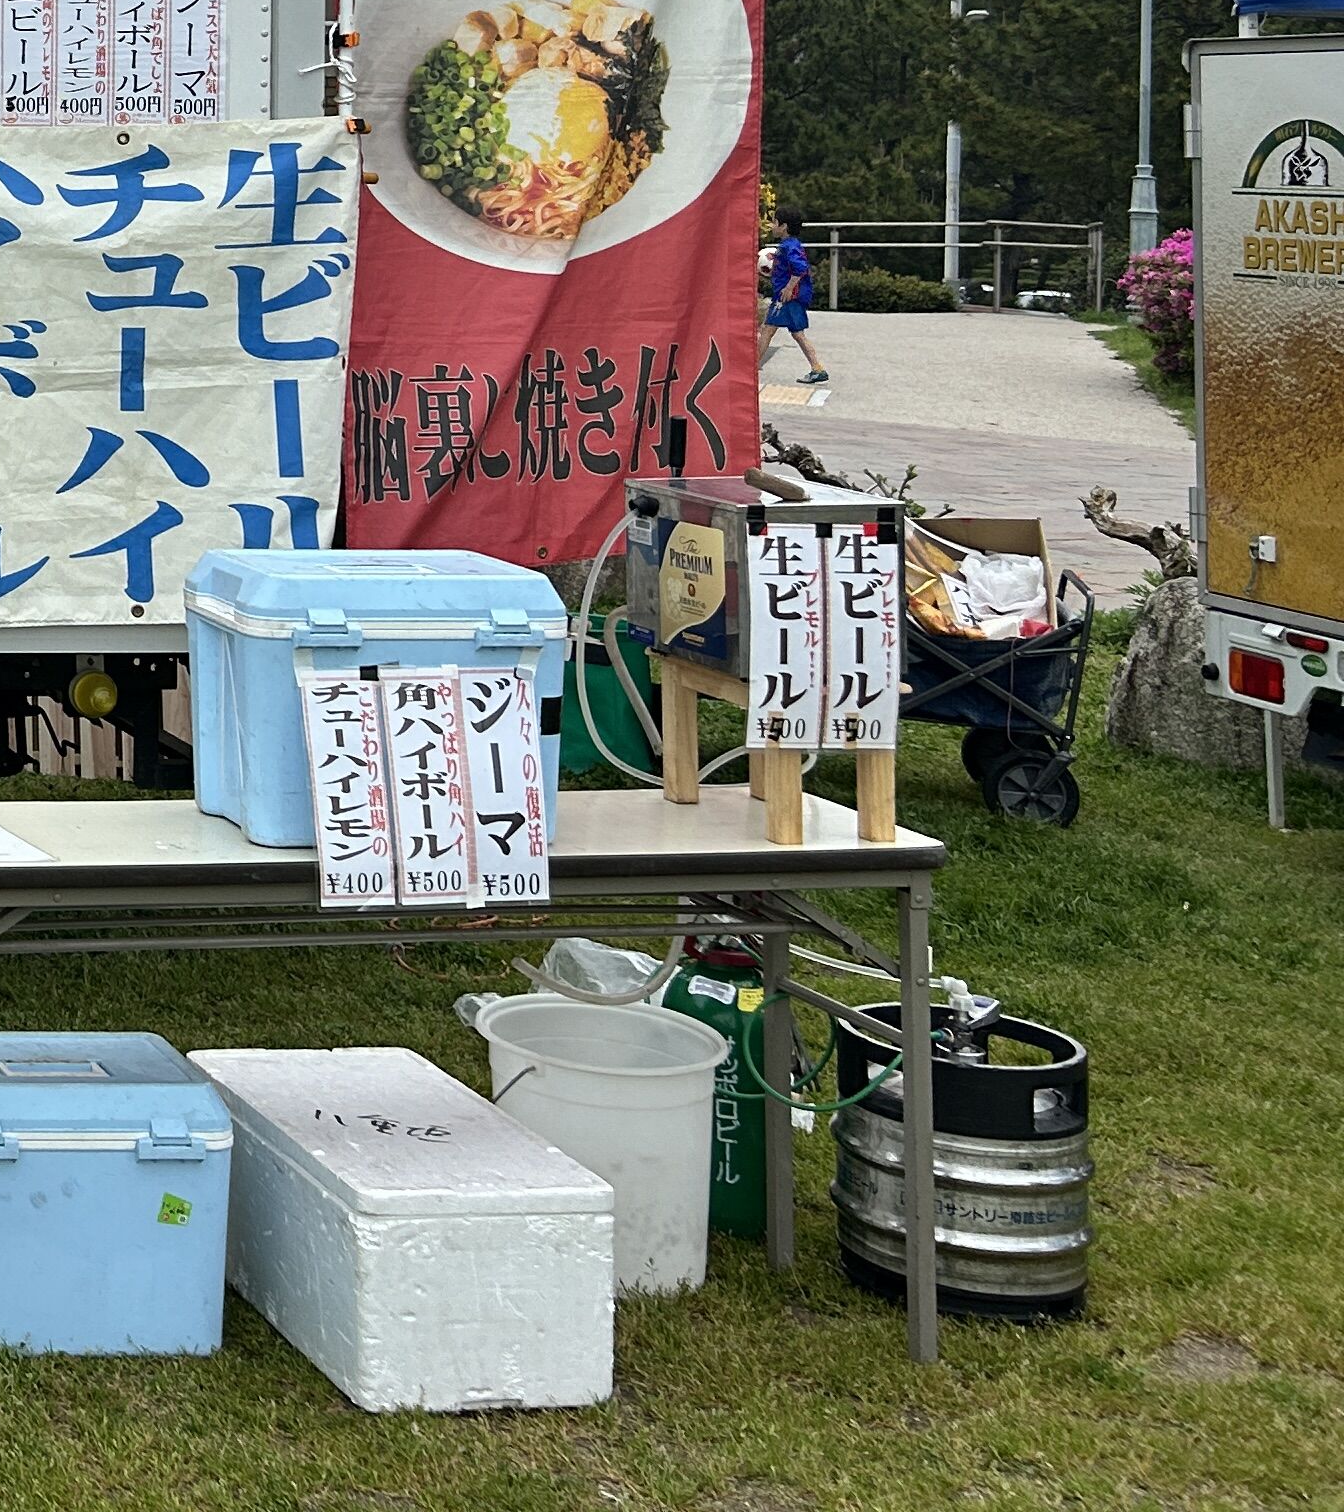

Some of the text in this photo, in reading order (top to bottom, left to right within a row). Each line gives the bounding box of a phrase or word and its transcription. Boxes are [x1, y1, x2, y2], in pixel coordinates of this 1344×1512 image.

[60, 97, 102, 115] 400円
[114, 96, 161, 113] 500円
[173, 98, 216, 116] 500円
[55, 144, 210, 604] チューハイ
[214, 142, 352, 550] 生ビール
[669, 548, 713, 576] PREMIUM
[758, 536, 808, 710] 生ビール
[835, 534, 883, 710] 生ビール
[312, 682, 374, 861] チューハイレモン
[359, 686, 388, 858] こだわり酒場の
[391, 682, 454, 860] 角ハイボール
[437, 683, 464, 857] やっぱり角ハイ
[466, 678, 526, 856] ジーマ
[516, 679, 544, 858] 久々の復活
[327, 872, 383, 894] ¥400
[408, 870, 461, 892] ¥500
[483, 873, 541, 896] ¥500
